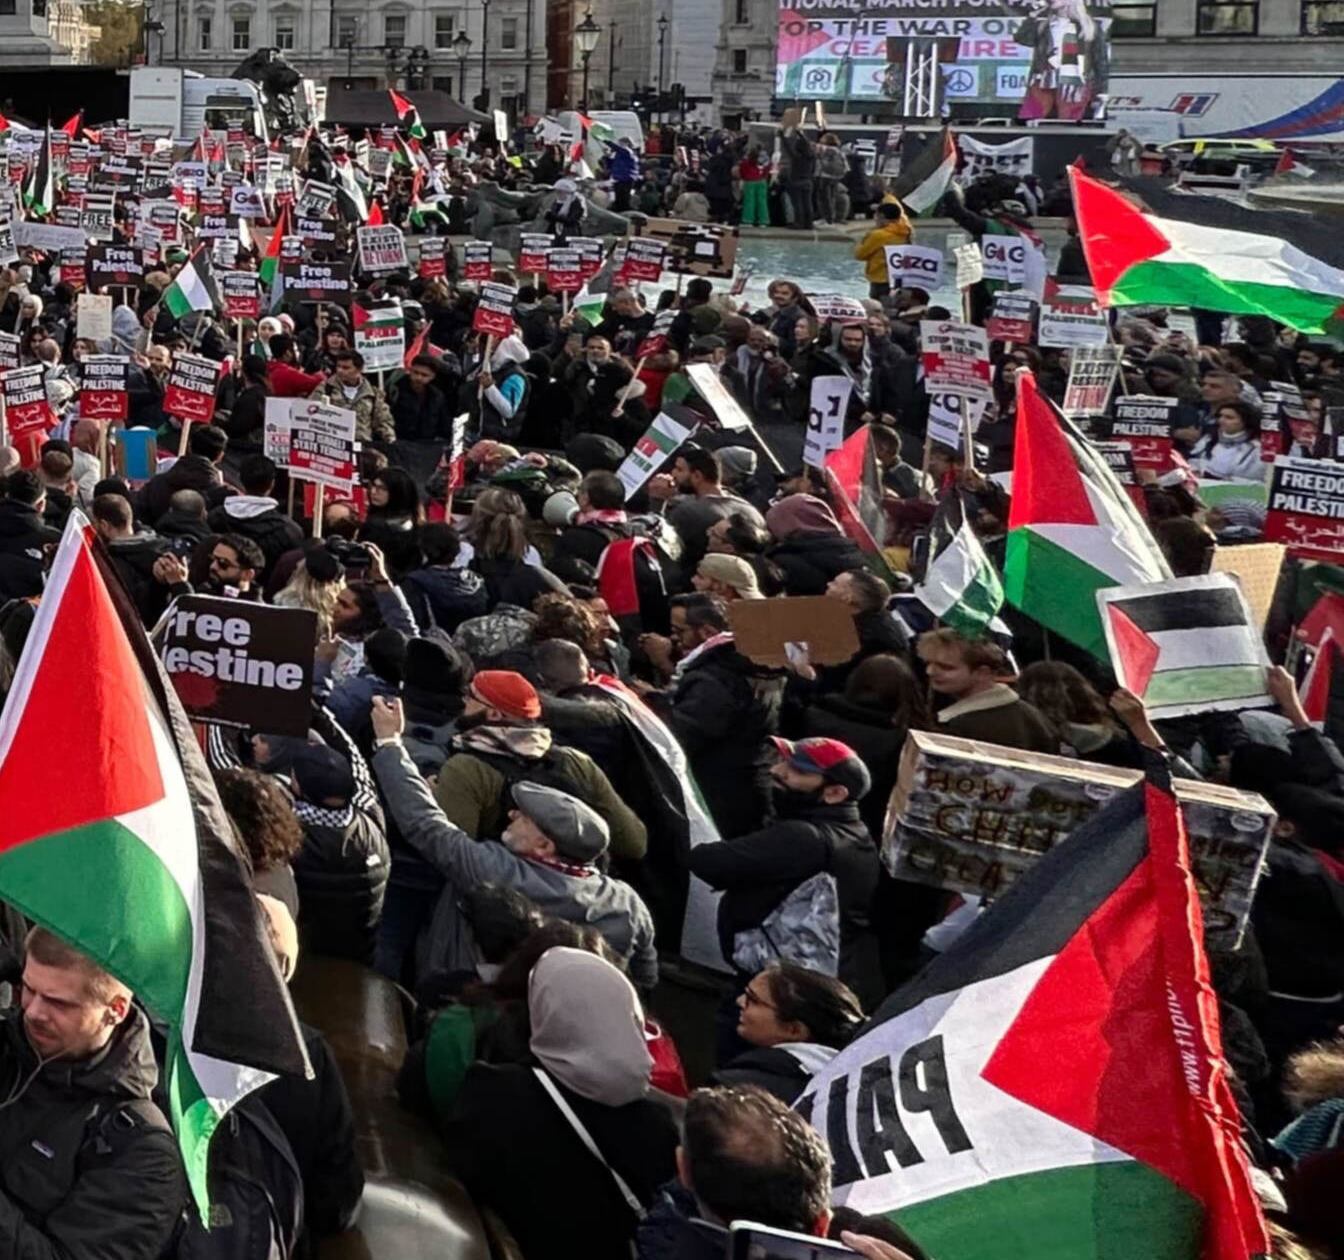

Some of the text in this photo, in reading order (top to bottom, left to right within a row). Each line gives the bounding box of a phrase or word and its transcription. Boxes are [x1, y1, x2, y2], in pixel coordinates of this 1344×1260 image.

[833, 20, 887, 36] THE
[898, 20, 972, 36] WAR
[81, 214, 111, 226] FREE
[297, 217, 323, 230] Free
[105, 249, 134, 261] Free
[889, 252, 938, 272] Gaza
[300, 265, 332, 278] Free
[285, 277, 349, 290] Palestine
[84, 364, 124, 375] FREEDOM
[175, 360, 216, 380] FREEDOM
[5, 374, 42, 391] FREEDOM
[82, 379, 125, 391] PALESTINE
[170, 375, 216, 396] PALESTINE
[6, 389, 46, 406] PALESTINE
[1117, 405, 1170, 419] FREEDOM
[1112, 422, 1171, 437] PALESTINE
[1280, 470, 1344, 493] FREEDO
[1273, 493, 1344, 518] PALESTI
[164, 644, 304, 690] estine
[925, 767, 1013, 803] HOW
